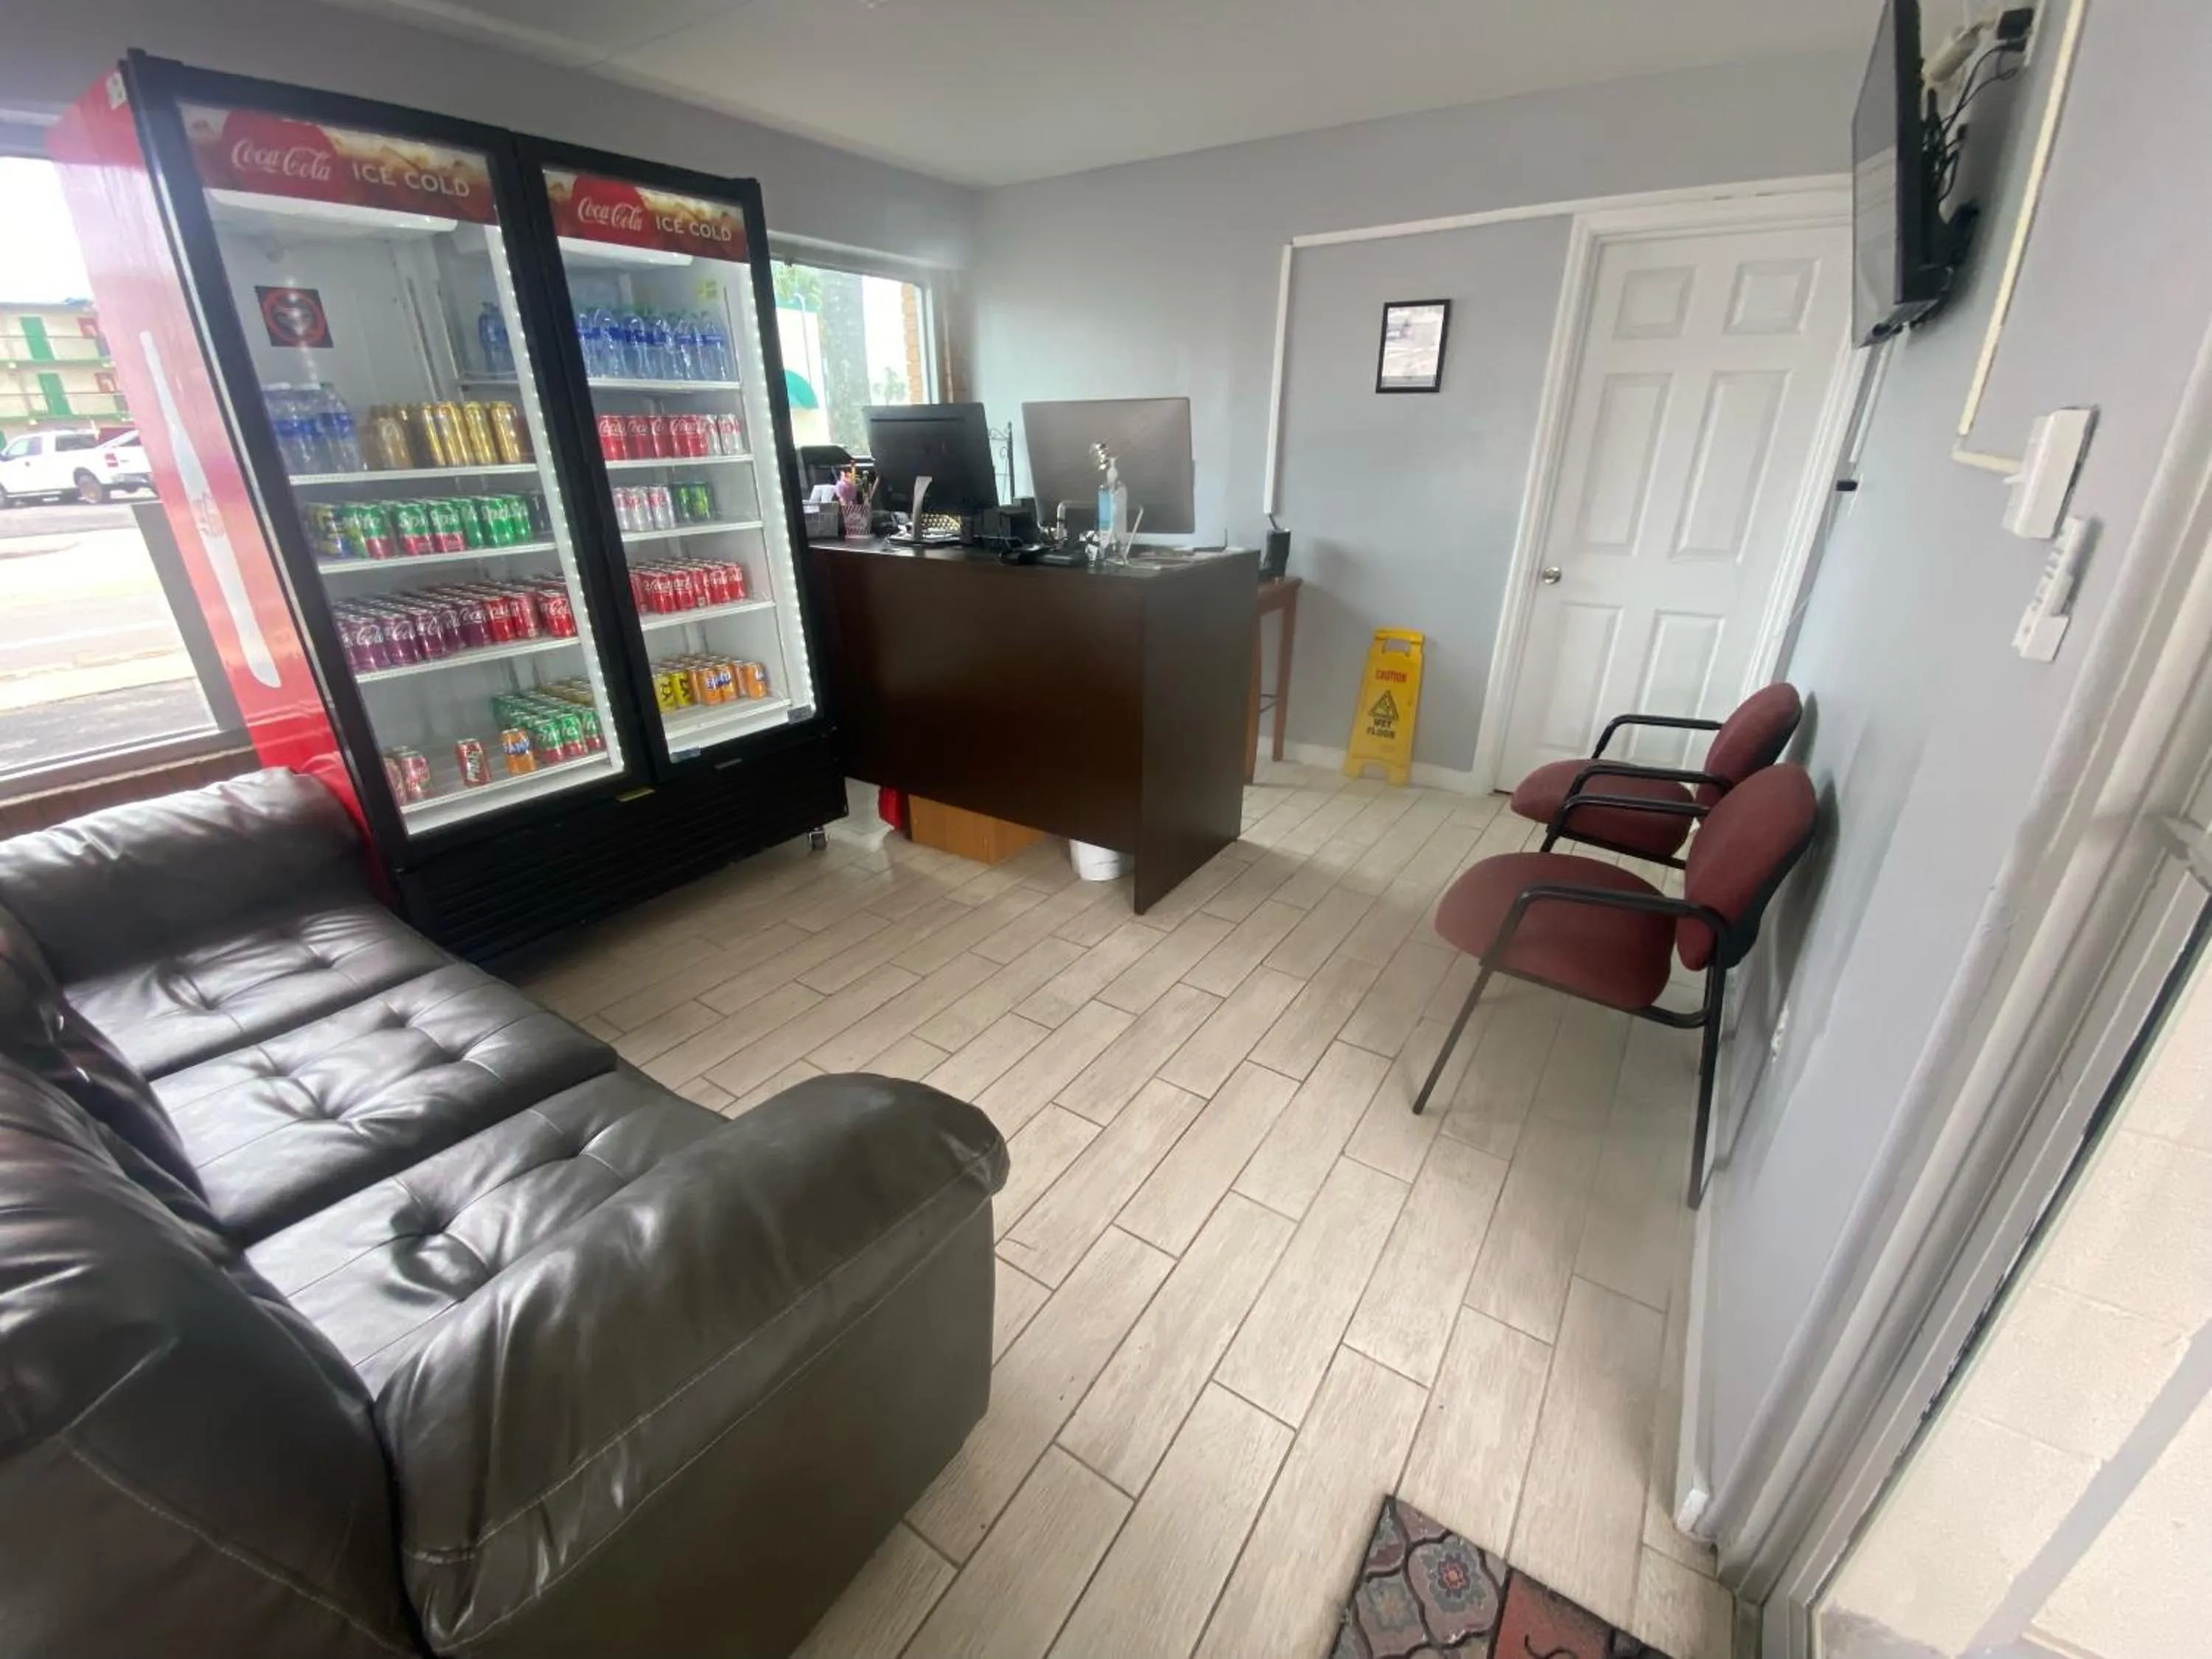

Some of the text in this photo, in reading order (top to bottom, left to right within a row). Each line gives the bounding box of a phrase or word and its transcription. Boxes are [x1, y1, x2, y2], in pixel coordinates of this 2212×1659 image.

[352, 161, 397, 188] ICE
[404, 170, 470, 198] COLD
[655, 215, 685, 234] ICE
[689, 221, 732, 243] COLD
[1374, 717, 1392, 728] WET
